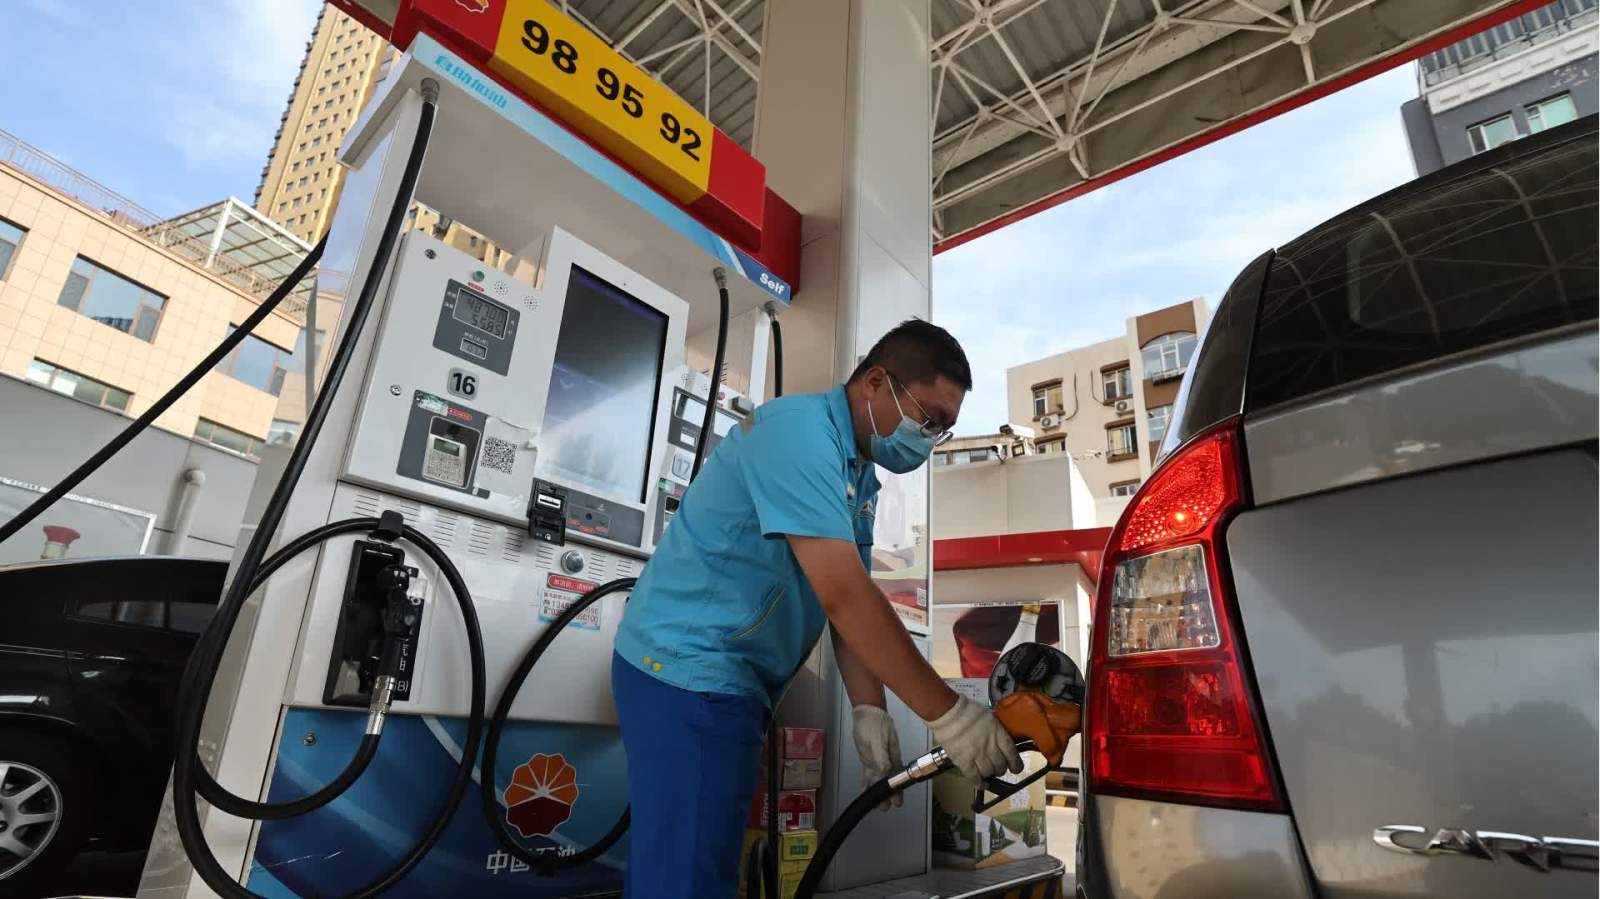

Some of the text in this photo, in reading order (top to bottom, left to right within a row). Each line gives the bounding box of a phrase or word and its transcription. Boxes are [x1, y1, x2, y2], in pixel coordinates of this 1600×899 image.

[521, 19, 702, 162] 98 95 92
[759, 272, 785, 294] Self
[453, 372, 476, 396] 16
[677, 458, 691, 476] 17
